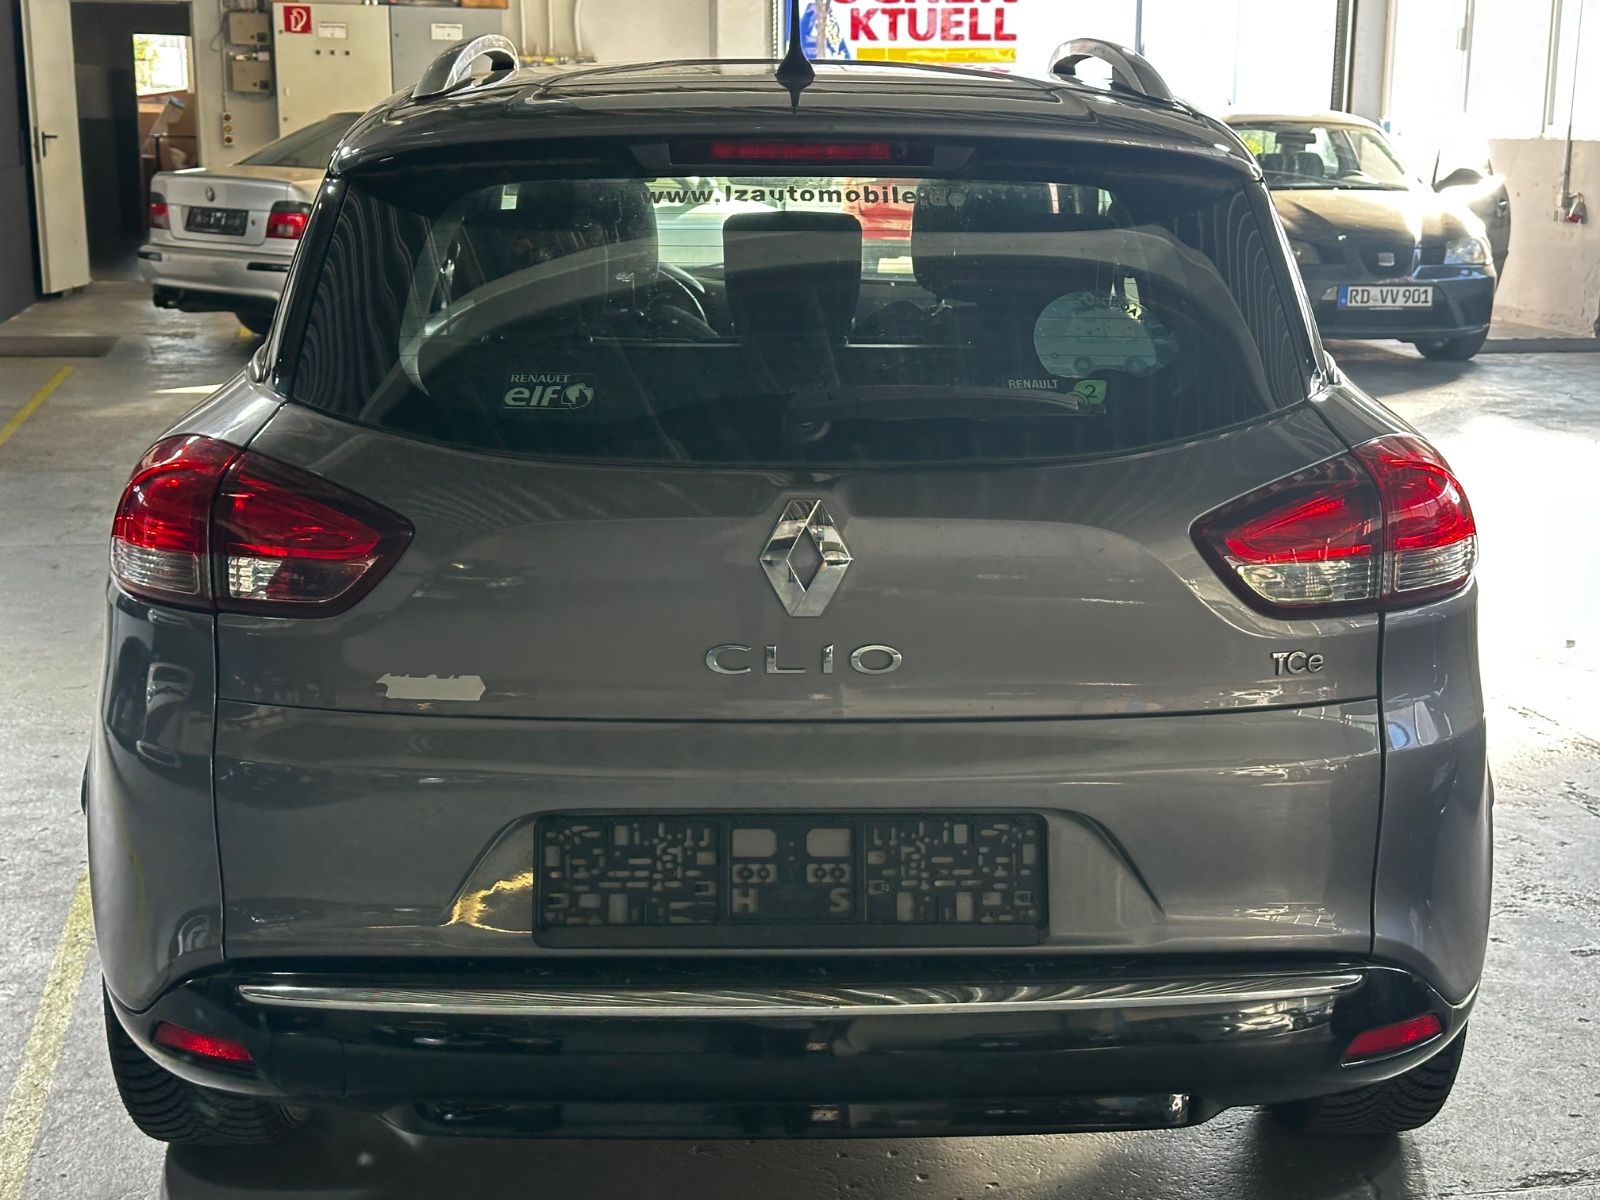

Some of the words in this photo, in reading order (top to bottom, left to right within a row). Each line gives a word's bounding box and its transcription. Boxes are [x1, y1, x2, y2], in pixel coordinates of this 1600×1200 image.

[1349, 288, 1371, 305] RD
[1379, 288, 1400, 305] VV
[1402, 288, 1430, 305] 901
[510, 374, 571, 384] RENAULT
[1008, 379, 1058, 389] RENAULT
[504, 385, 562, 407] elf
[1084, 384, 1099, 399] 2
[705, 643, 903, 676] CLIO
[1271, 650, 1325, 676] TCe
